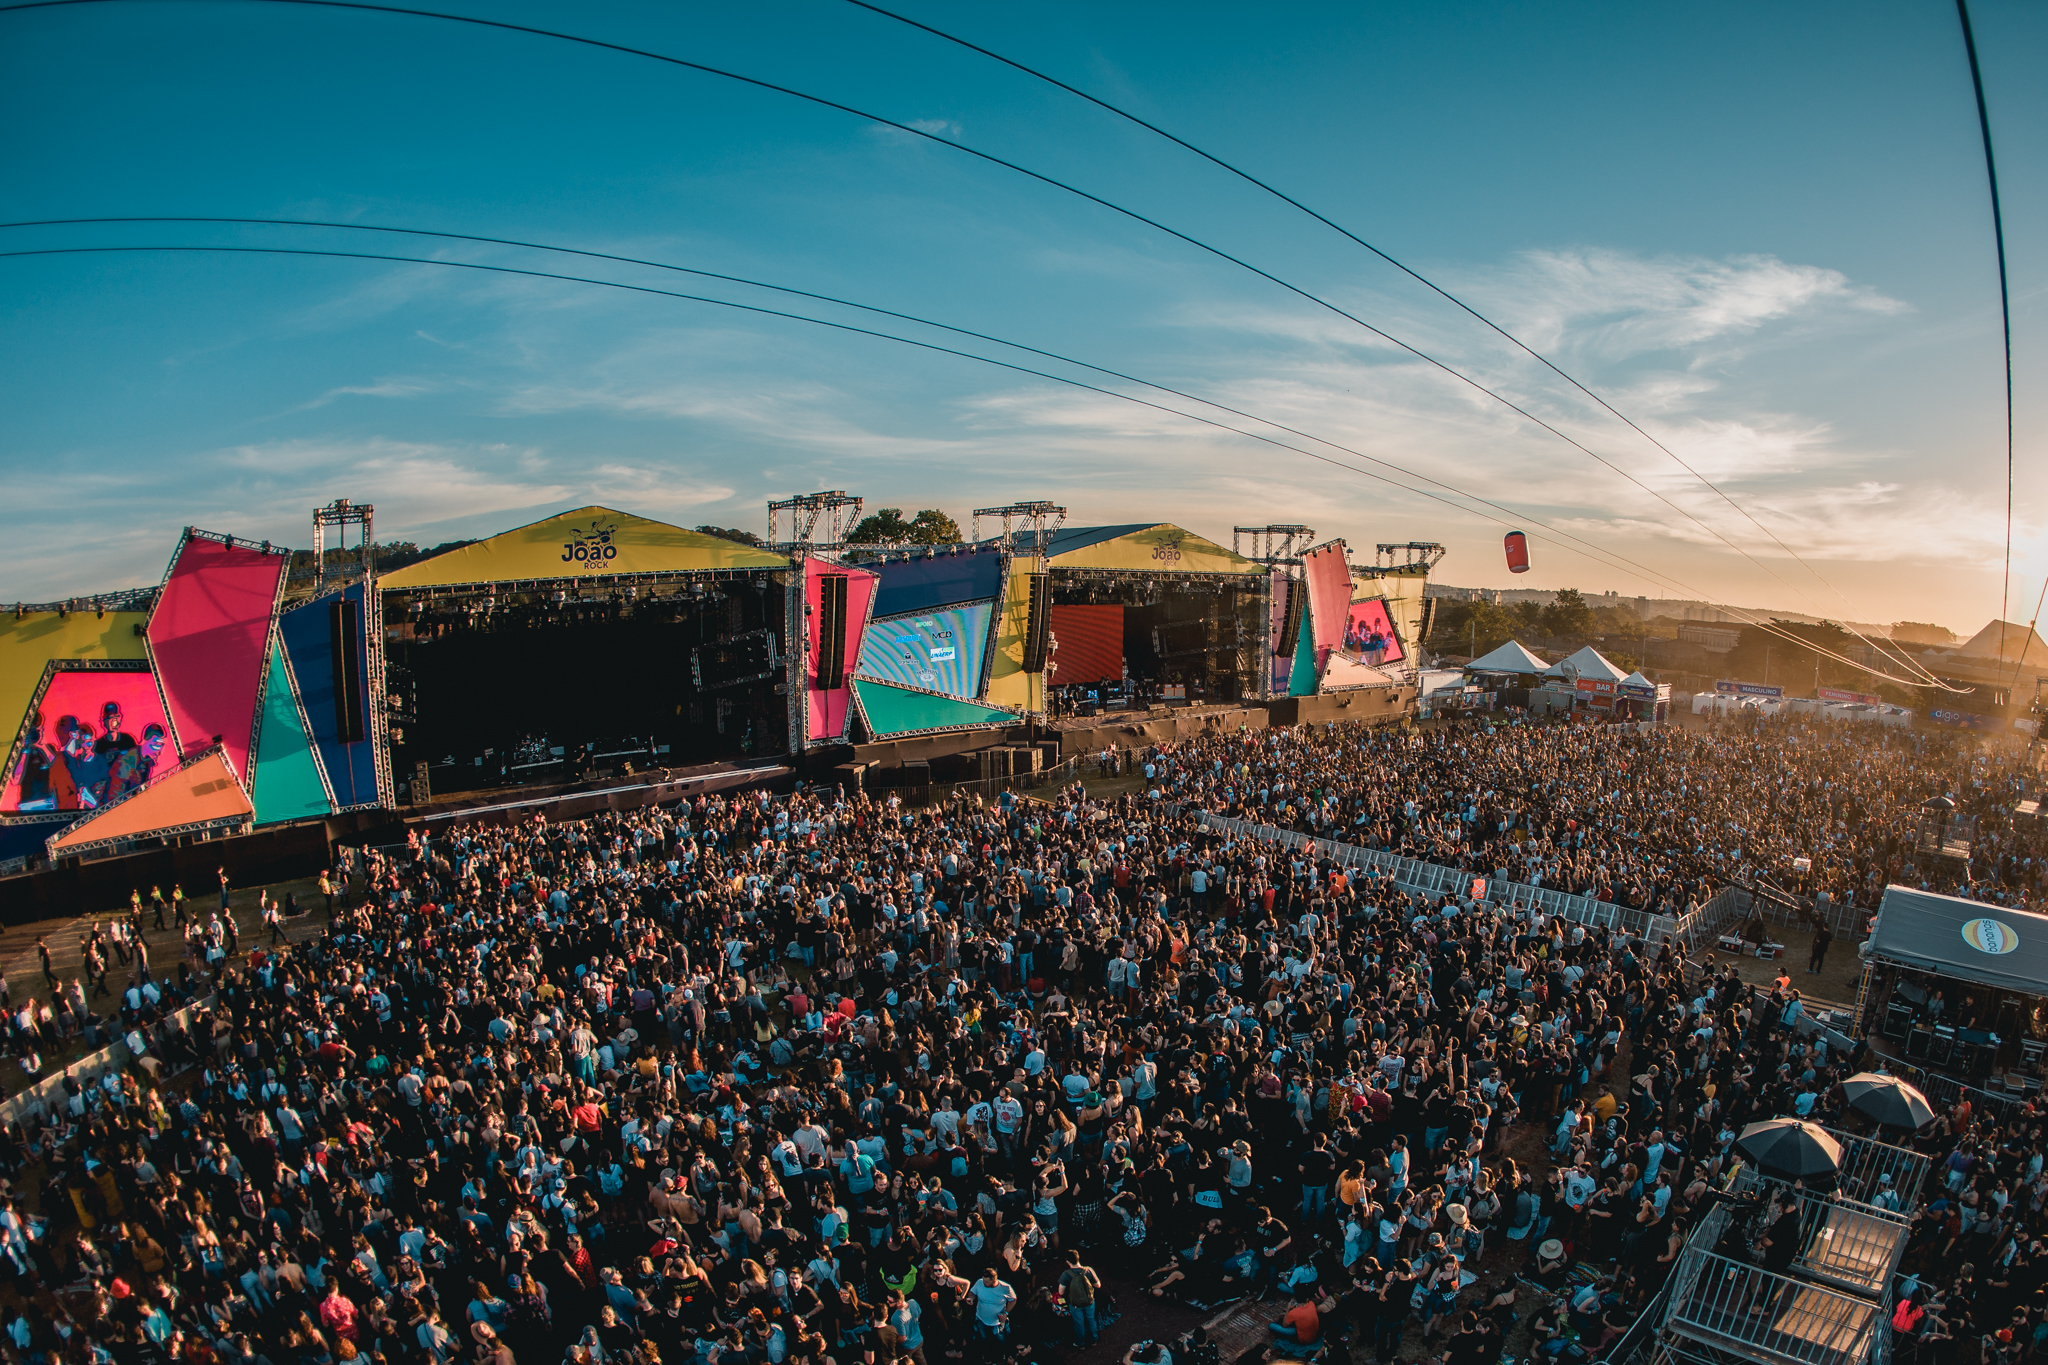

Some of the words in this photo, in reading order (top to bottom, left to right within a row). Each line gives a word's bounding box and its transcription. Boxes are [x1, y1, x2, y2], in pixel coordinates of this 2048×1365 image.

[561, 541, 617, 562] João
[1152, 547, 1181, 560] João
[584, 561, 609, 570] ROCK
[1596, 683, 1611, 692] BAR
[1742, 686, 1777, 695] MASCULINO
[1825, 691, 1852, 700] FEMININO
[1935, 709, 1960, 722] digio
[1982, 919, 1998, 953] bananas
